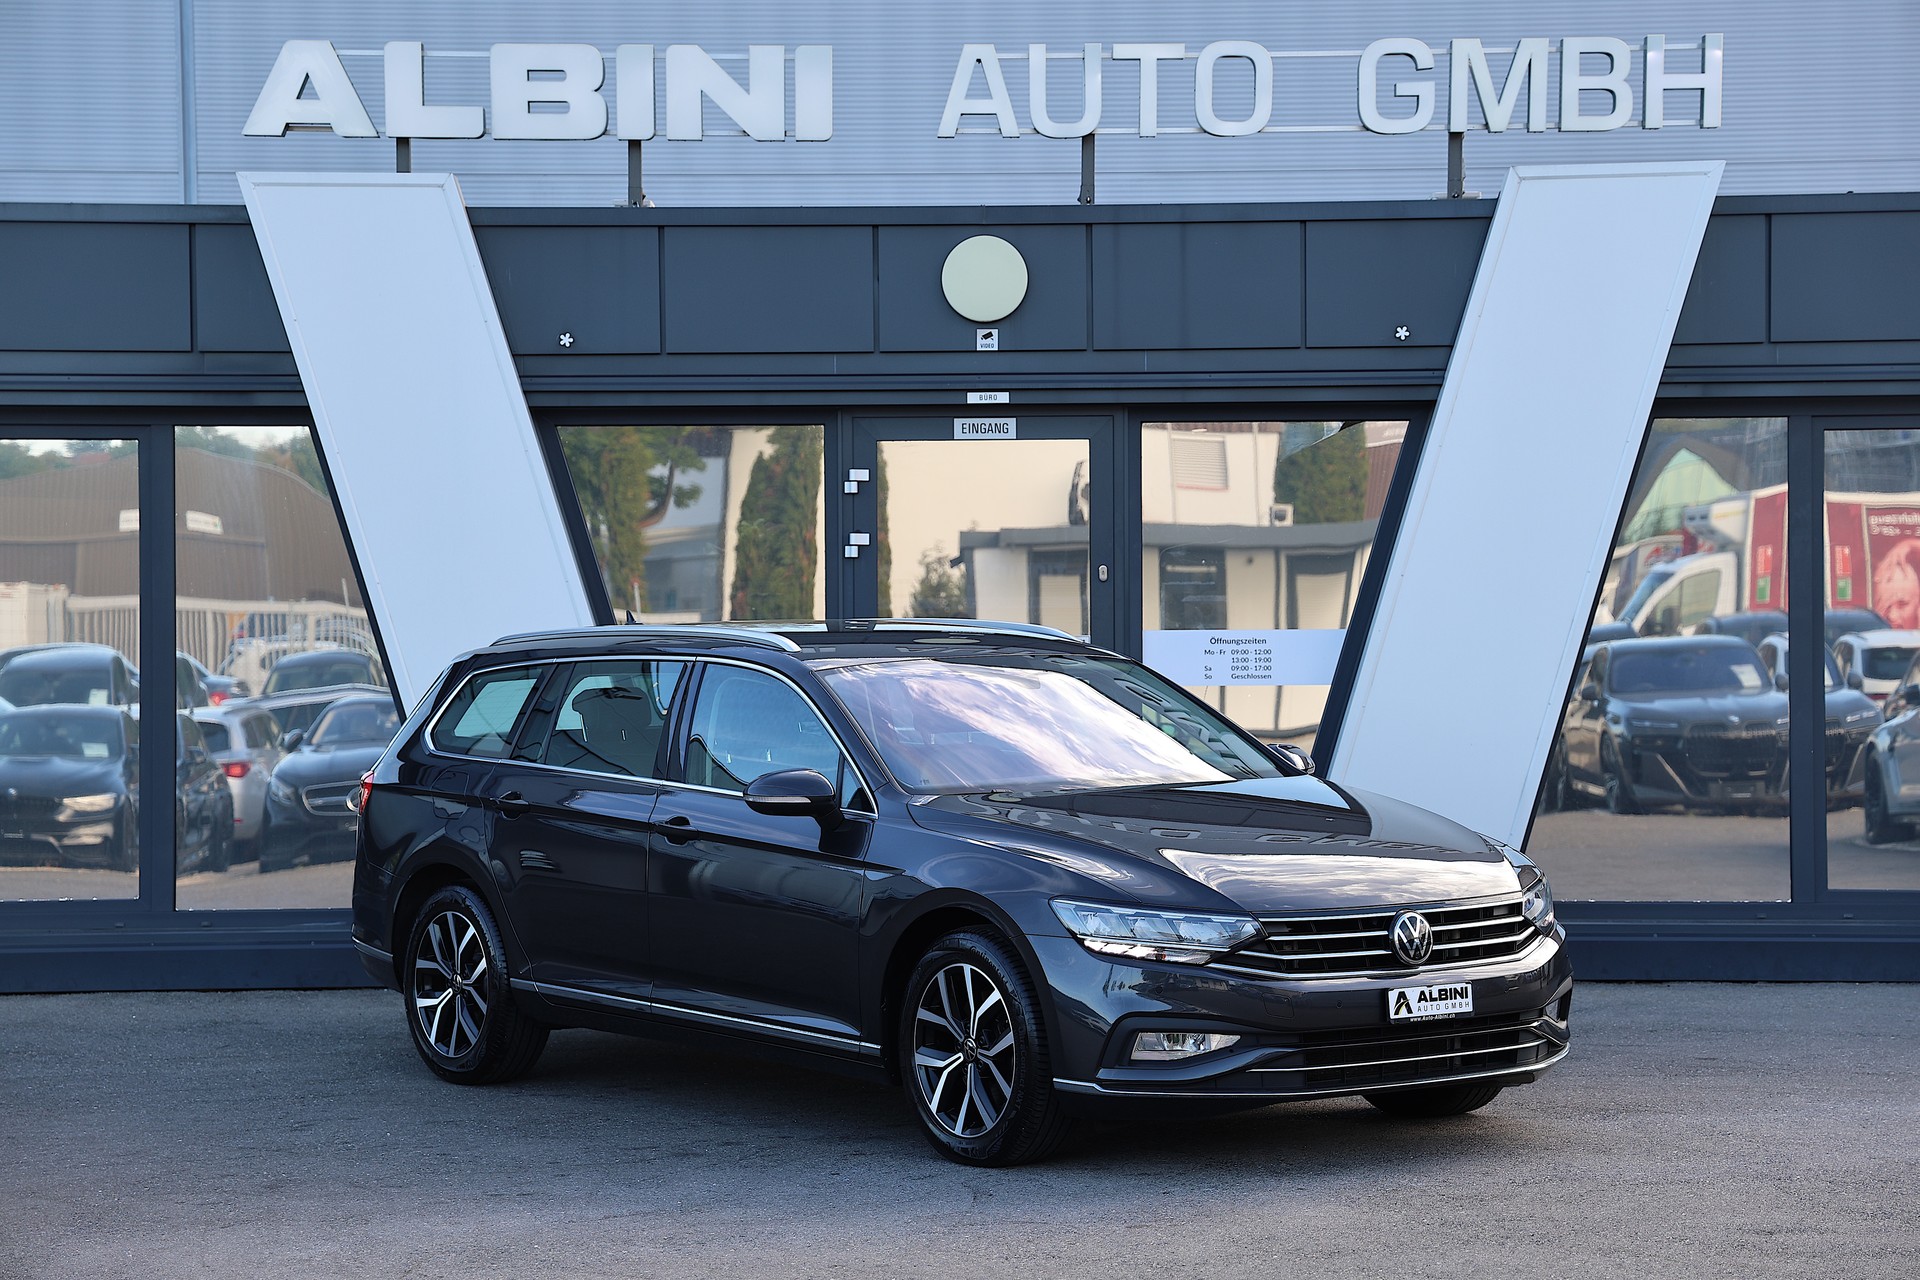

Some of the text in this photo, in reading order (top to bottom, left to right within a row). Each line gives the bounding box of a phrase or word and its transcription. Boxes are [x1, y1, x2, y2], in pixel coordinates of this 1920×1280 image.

[242, 33, 1724, 141] ALBINI AUTO GMBH
[961, 422, 1009, 434] EINGANG
[1209, 636, 1267, 646] Öffnungszeiten
[1417, 986, 1469, 1003] ALBINI
[1417, 1001, 1470, 1012] AUTO GMBH
